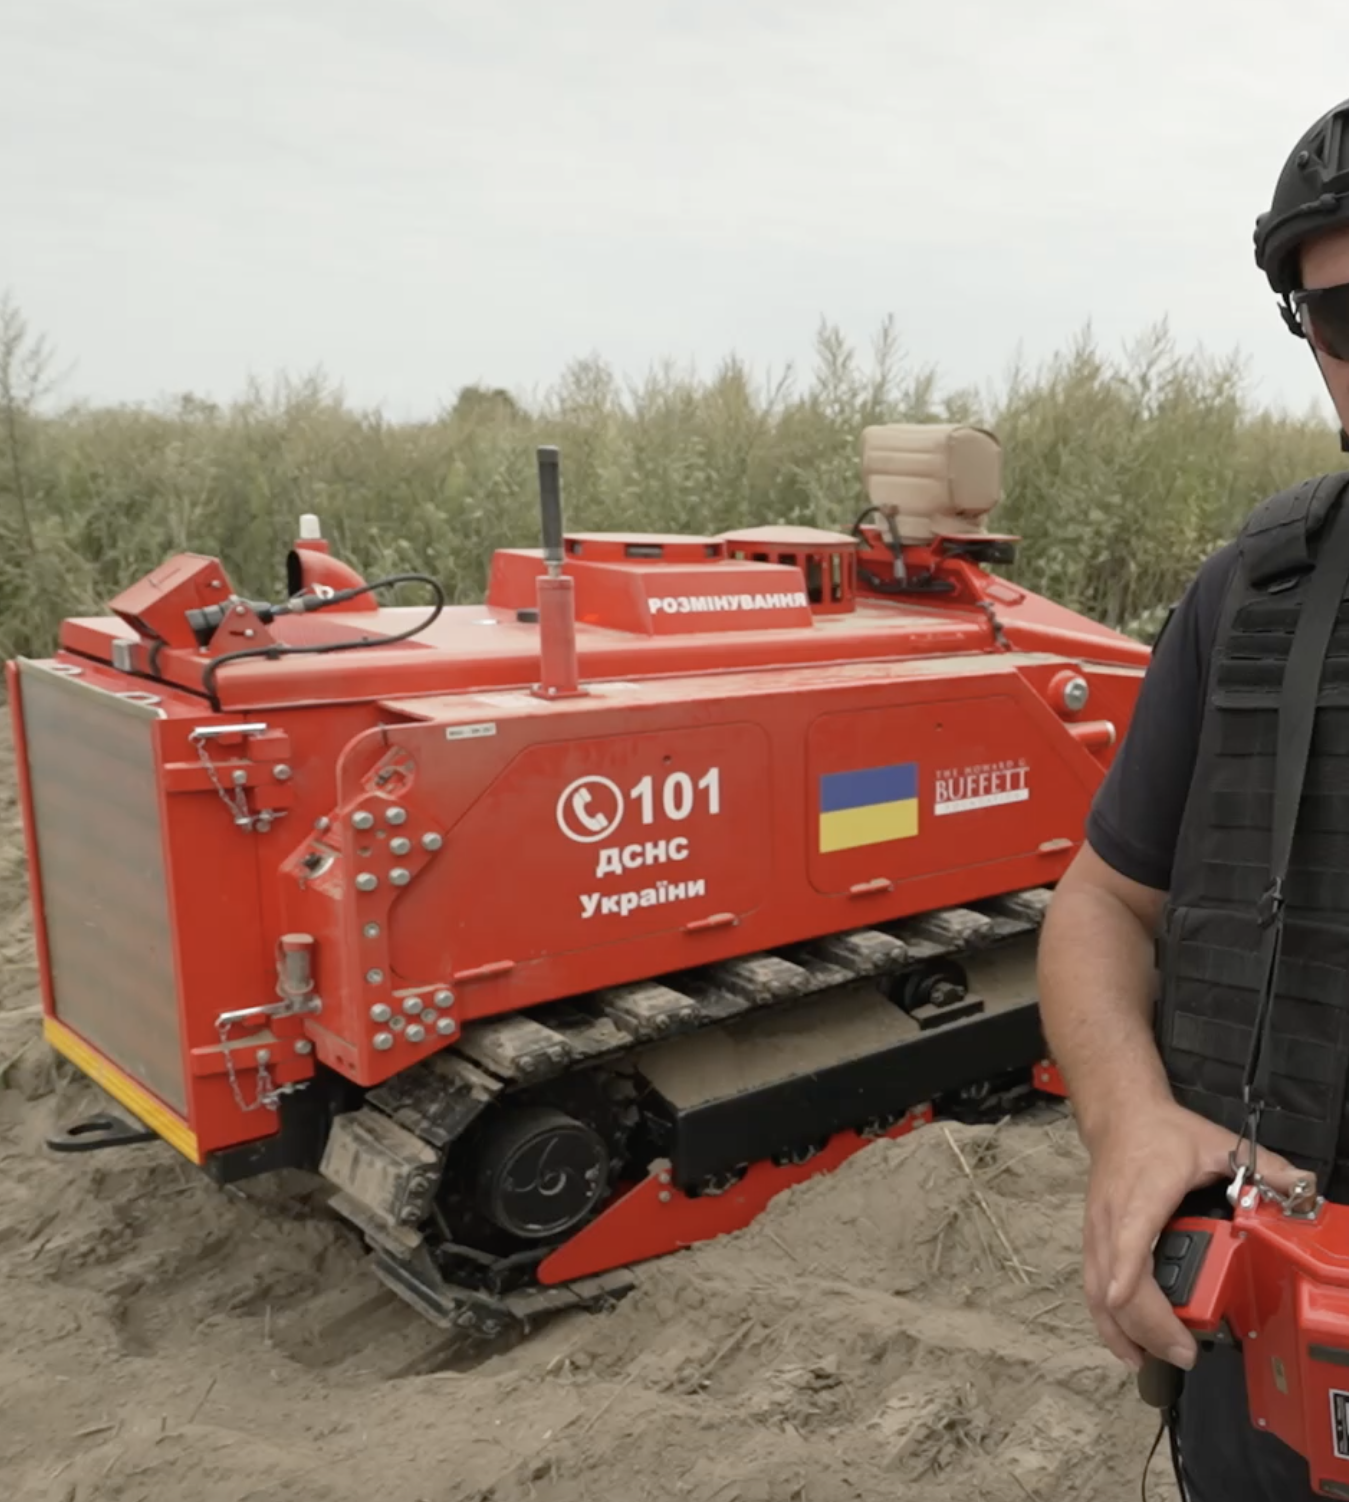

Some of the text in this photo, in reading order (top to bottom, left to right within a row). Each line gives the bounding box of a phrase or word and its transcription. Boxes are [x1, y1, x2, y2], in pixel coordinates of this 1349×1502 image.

[648, 592, 808, 614] РОЗМІНУВАННЯ
[630, 767, 720, 824] 101
[935, 767, 1030, 803] BUFFETT
[596, 836, 689, 878] ДСНС
[579, 879, 706, 918] України
